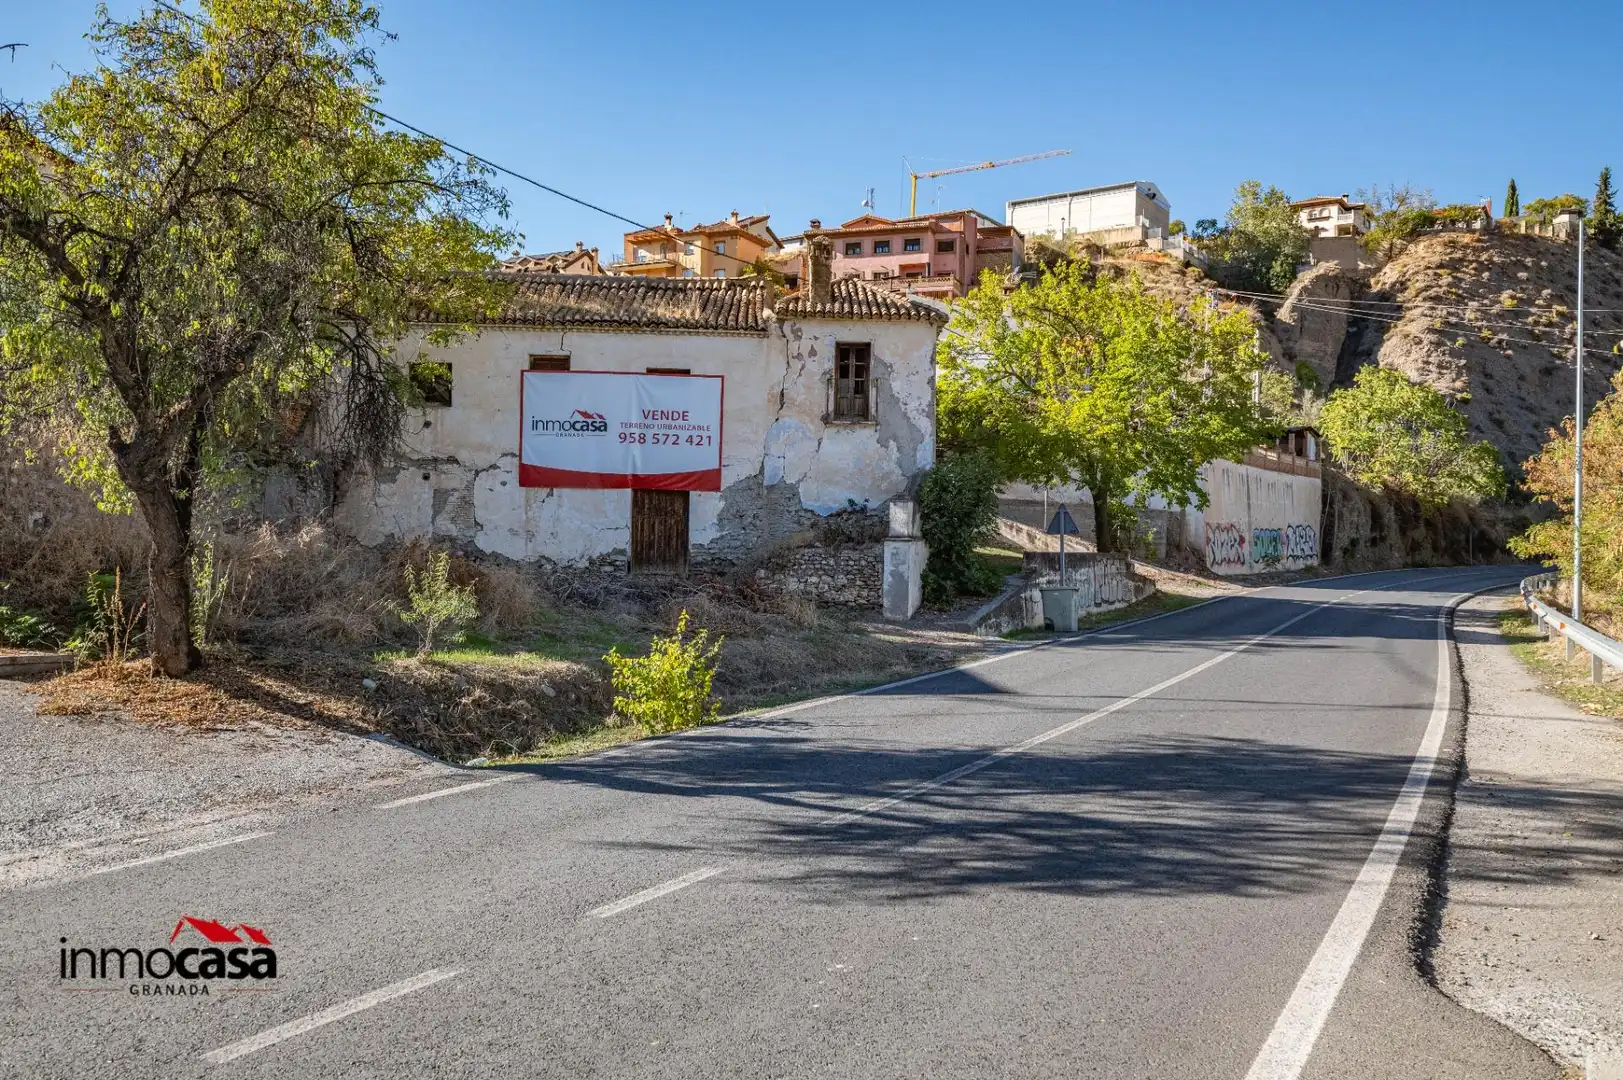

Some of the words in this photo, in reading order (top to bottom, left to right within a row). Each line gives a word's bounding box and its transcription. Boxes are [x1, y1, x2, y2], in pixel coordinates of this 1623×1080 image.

[642, 409, 690, 421] VENDE
[531, 416, 608, 432] inmocasa
[619, 422, 655, 430] TERRENO
[657, 423, 711, 432] URBANIZABLE
[618, 432, 647, 445] 958
[651, 433, 680, 446] 572
[685, 434, 712, 447] 421
